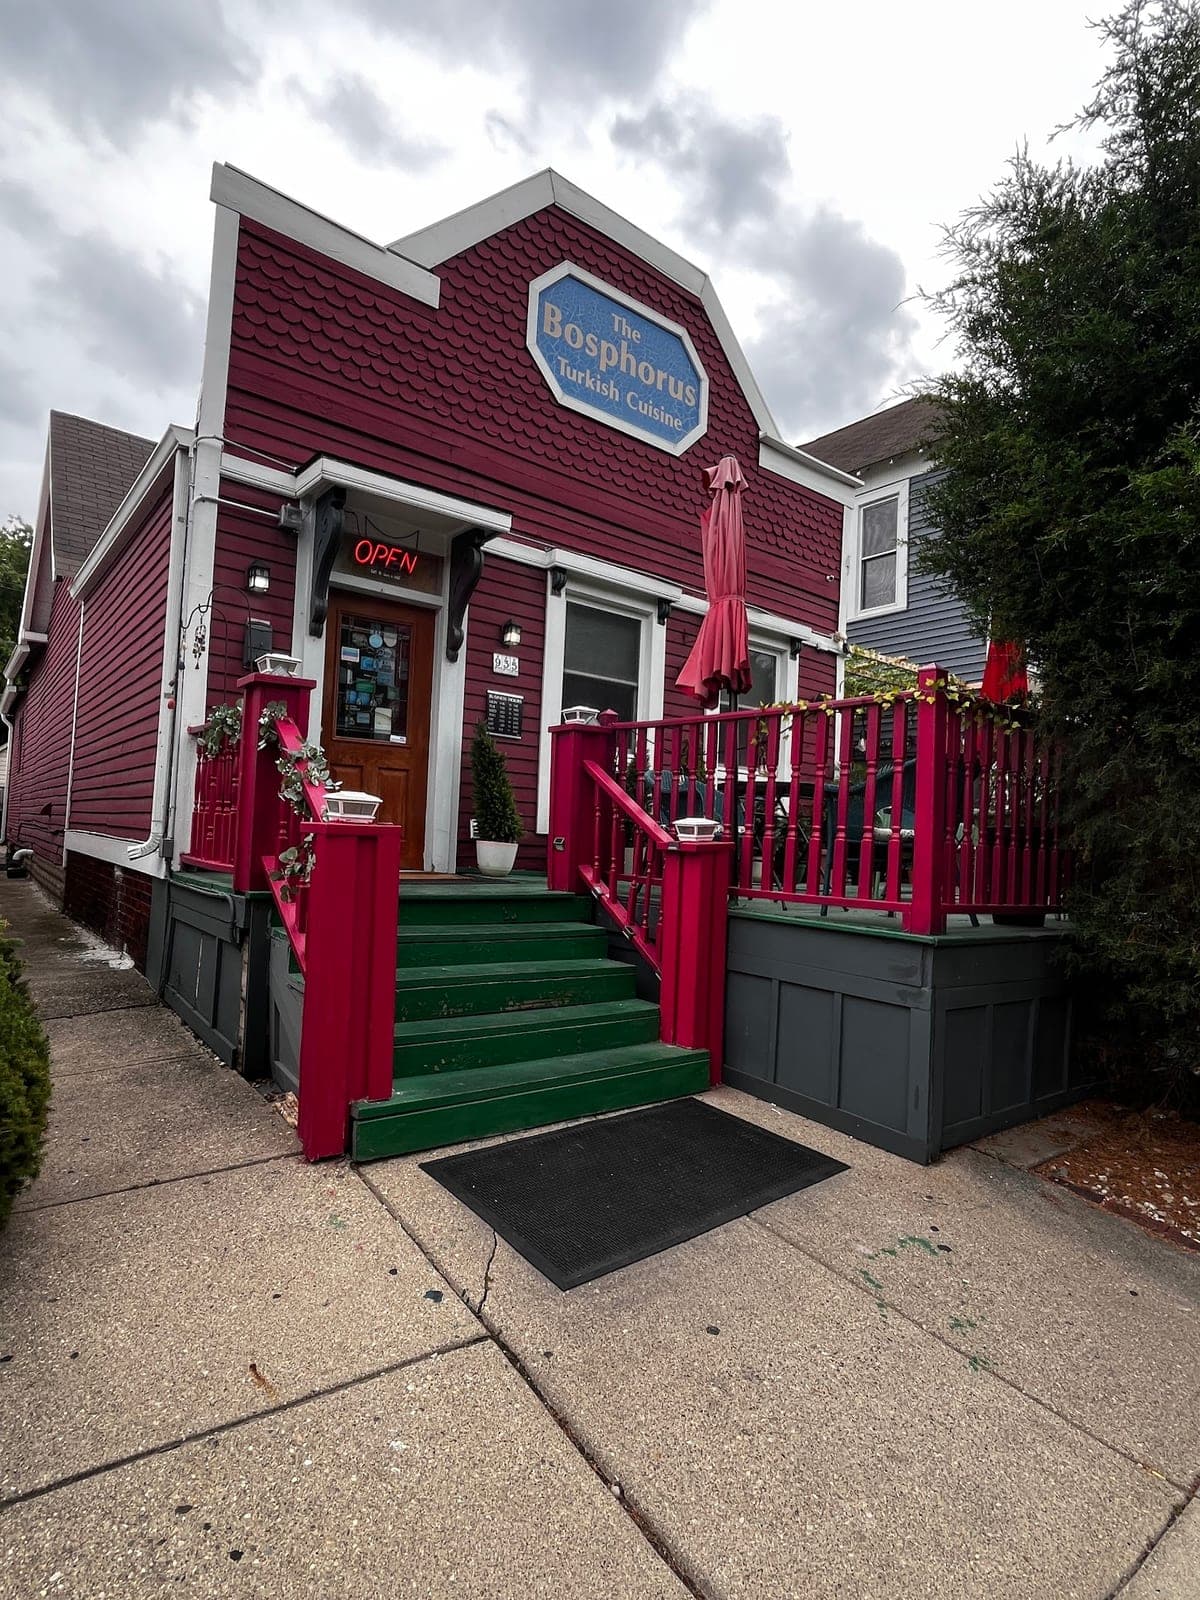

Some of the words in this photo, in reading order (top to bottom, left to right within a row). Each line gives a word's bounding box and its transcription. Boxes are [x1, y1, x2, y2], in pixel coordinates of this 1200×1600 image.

[611, 313, 641, 344] The
[543, 302, 696, 407] Bosphorus
[557, 356, 620, 402] Turkish
[626, 391, 683, 431] Cuisine
[355, 540, 418, 574] OPEN
[495, 655, 517, 672] 935
